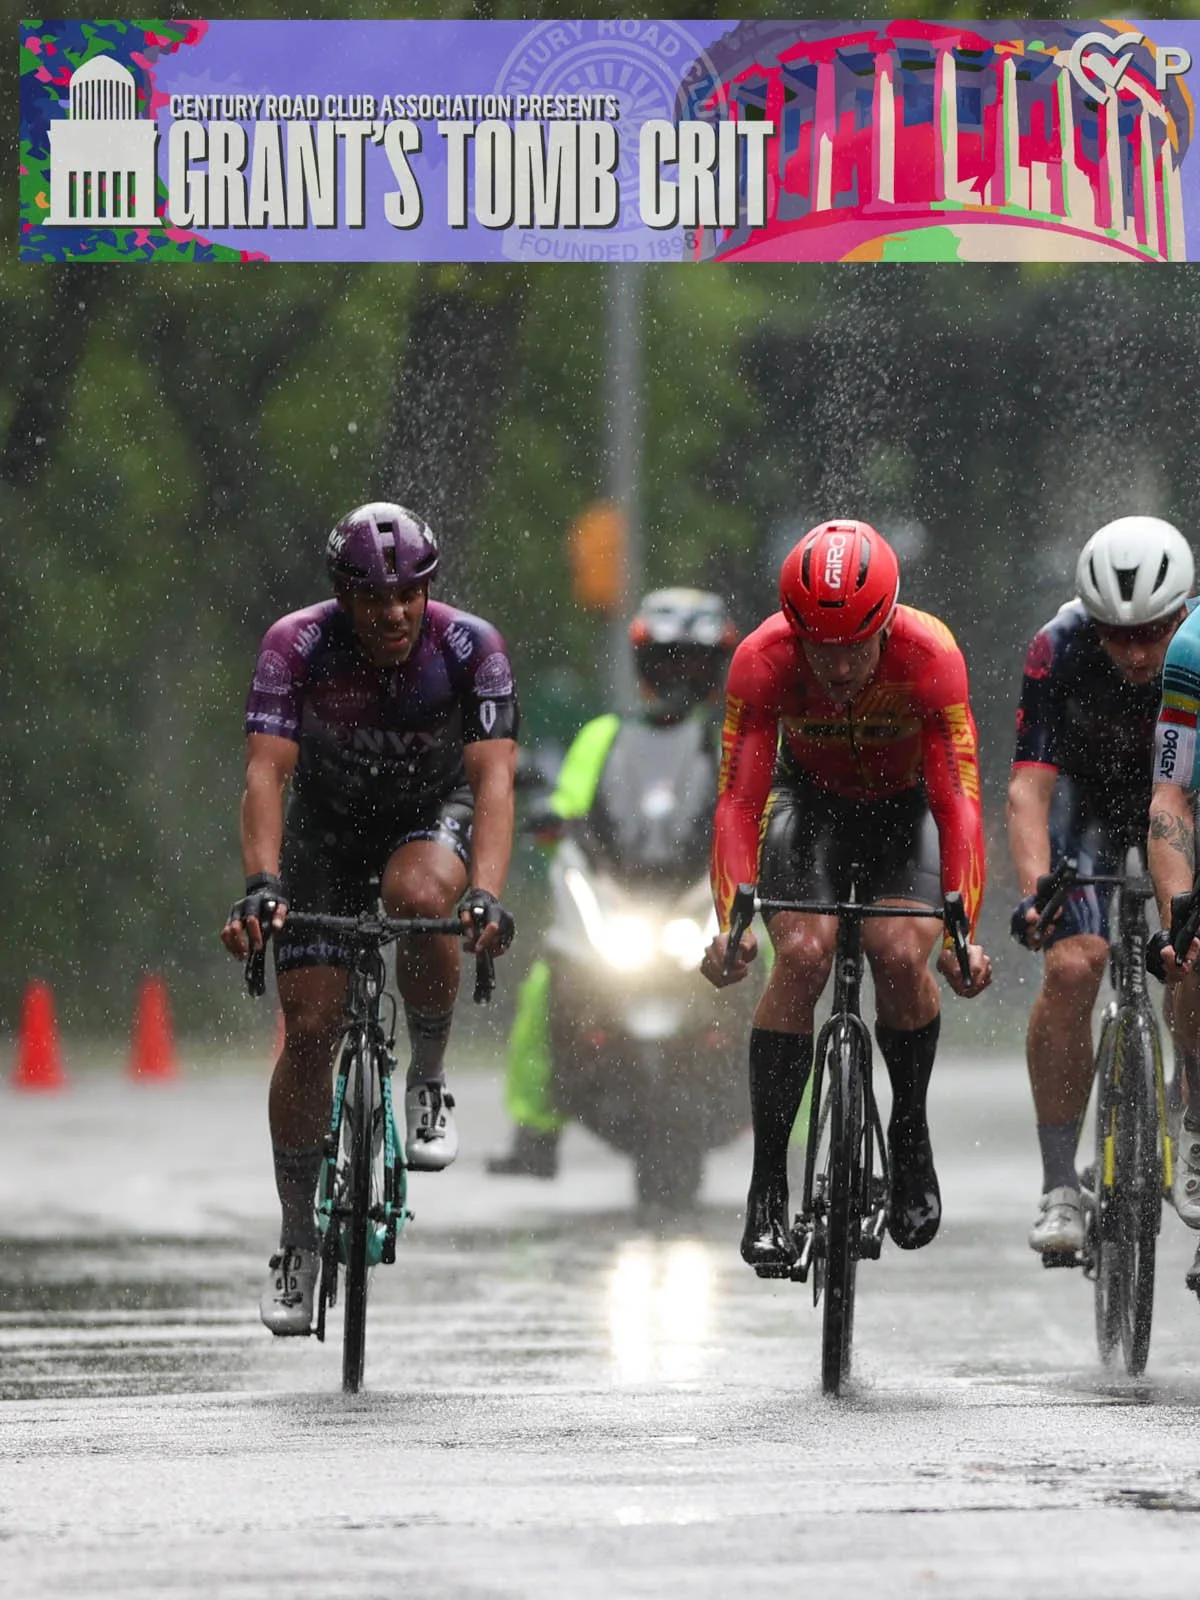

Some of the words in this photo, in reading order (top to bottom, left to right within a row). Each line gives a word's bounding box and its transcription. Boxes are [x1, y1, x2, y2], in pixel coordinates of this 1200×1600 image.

[824, 533, 847, 589] GIRO
[1160, 729, 1179, 779] OAKLEY
[1131, 935, 1143, 994] FACTOR
[382, 1075, 394, 1169] Bianchi
